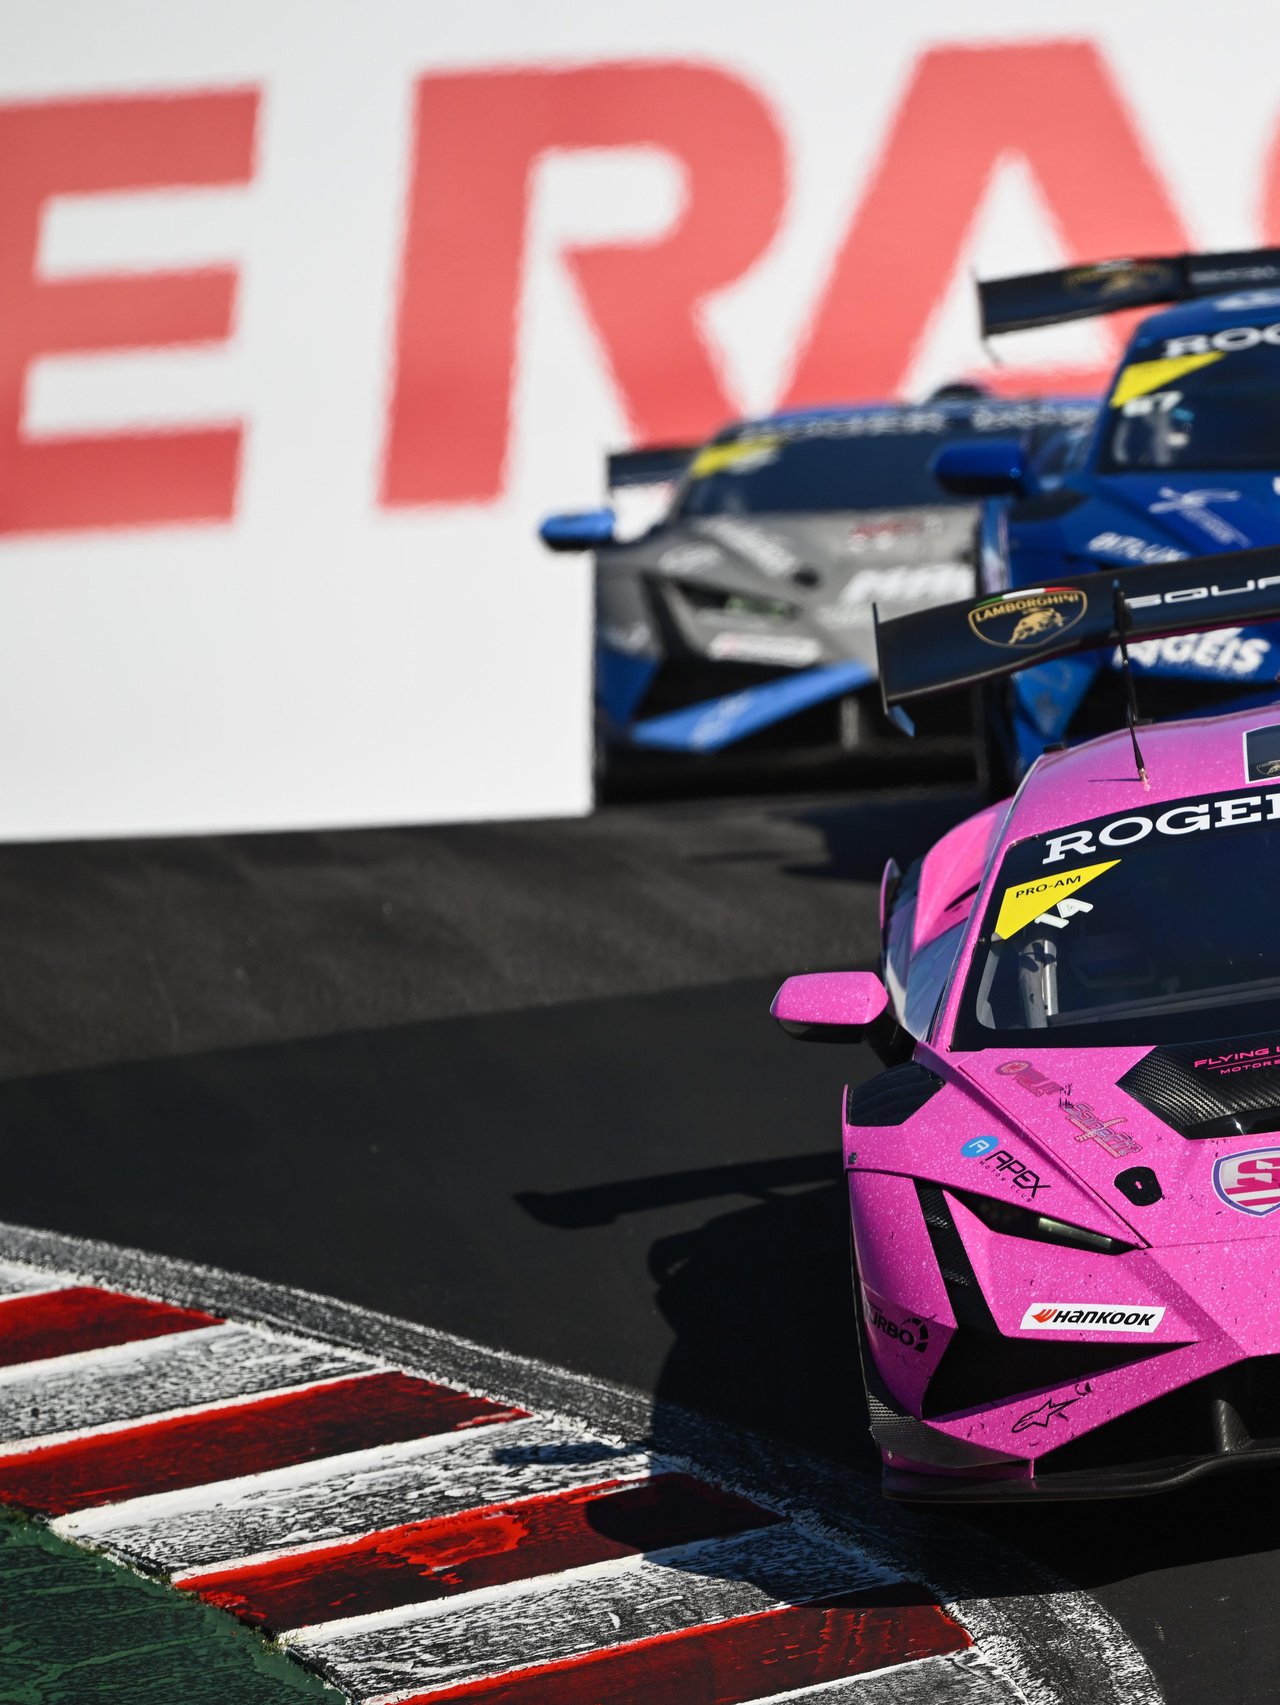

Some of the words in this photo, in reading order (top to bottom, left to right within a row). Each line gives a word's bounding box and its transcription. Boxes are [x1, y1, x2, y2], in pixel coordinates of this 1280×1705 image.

[975, 593, 1080, 622] LAMBORGHINI
[1015, 874, 1082, 899] PRO-AM
[1194, 1047, 1270, 1069] FLYING
[984, 1149, 1052, 1199] APEX
